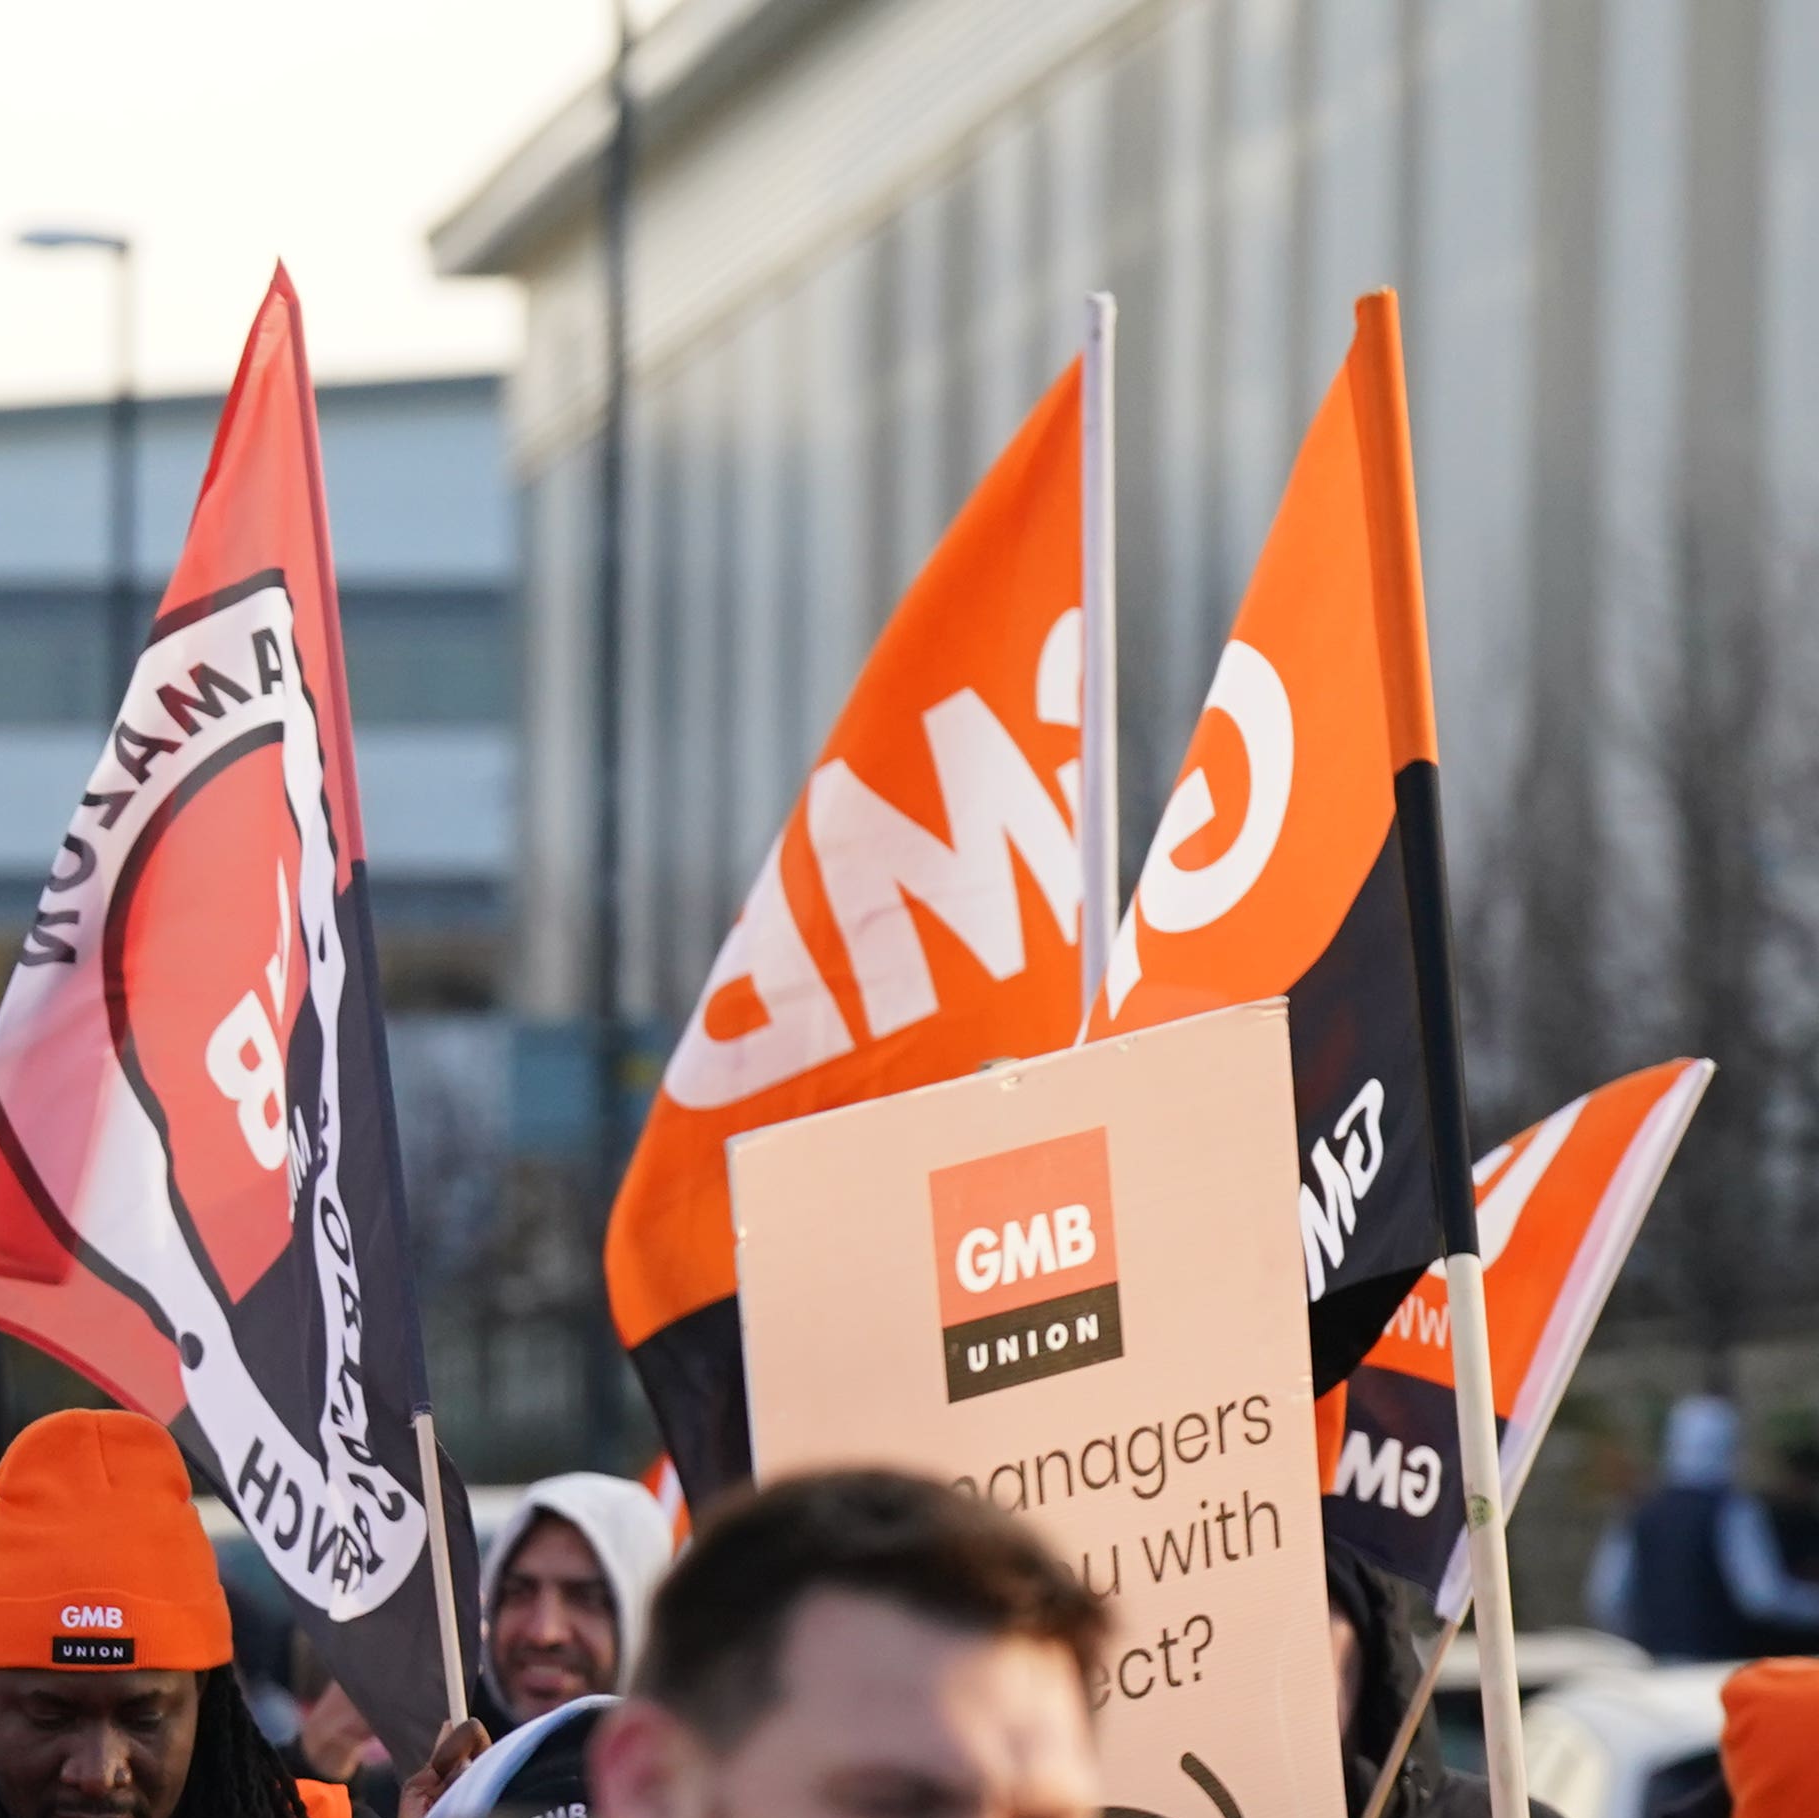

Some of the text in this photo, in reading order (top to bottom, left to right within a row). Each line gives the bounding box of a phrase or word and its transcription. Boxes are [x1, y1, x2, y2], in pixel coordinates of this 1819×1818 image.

[954, 1203, 1098, 1294] GMB
[966, 1313, 1102, 1373] UNION
[949, 1393, 1275, 1516] anagers
[1141, 1489, 1282, 1585] with
[60, 1605, 123, 1629] GMB
[63, 1645, 124, 1658] UNION
[1092, 1613, 1217, 1714] ect?
